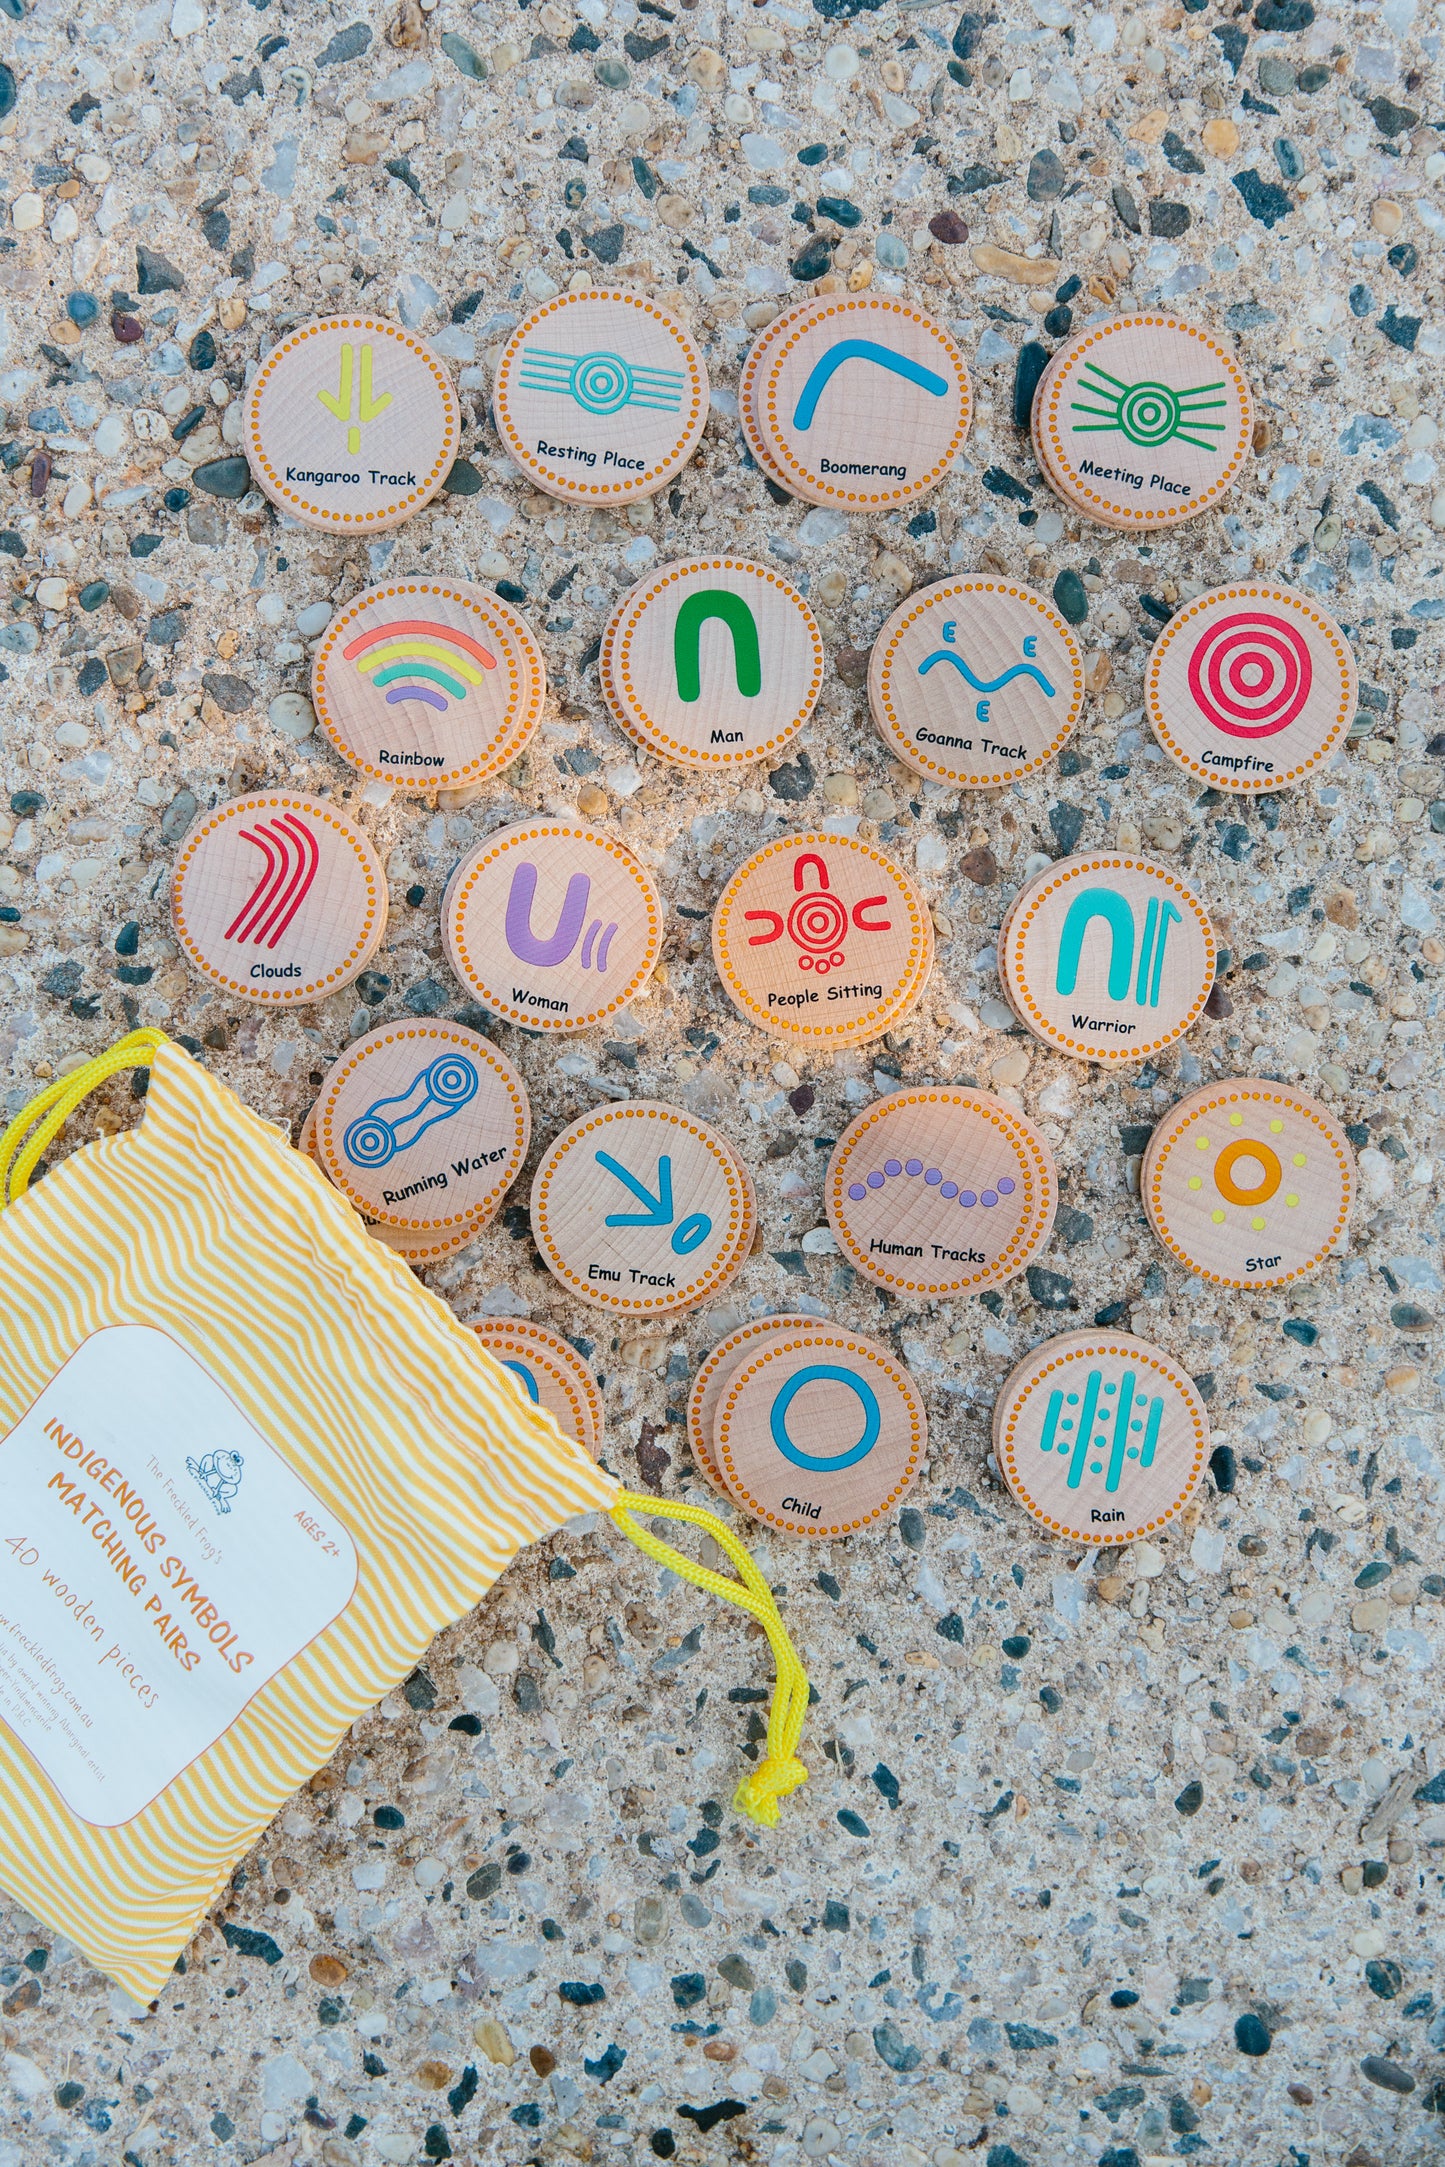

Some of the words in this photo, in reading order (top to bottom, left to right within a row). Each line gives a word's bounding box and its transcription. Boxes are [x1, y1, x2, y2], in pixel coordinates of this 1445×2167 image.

[537, 440, 597, 467] Resting
[603, 451, 645, 471] Place
[286, 466, 360, 487] Kangaroo
[368, 470, 416, 486] Track
[820, 458, 907, 481] Boomerang
[1079, 459, 1144, 489] Meeting
[1149, 474, 1192, 496] Place
[710, 729, 744, 744] Man
[915, 727, 973, 751] Goanna
[980, 738, 1028, 760] Track
[379, 749, 445, 767] Rainbow
[1201, 750, 1274, 773] Campfire
[249, 962, 302, 979] Clouds
[512, 987, 569, 1013] Woman
[768, 988, 820, 1009] People
[827, 984, 883, 1001] Sitting
[1071, 1014, 1136, 1035] Warrior
[382, 1172, 448, 1205] Running
[451, 1147, 507, 1177] Water
[869, 1238, 923, 1258] Human
[930, 1244, 986, 1264] Tracks
[1245, 1255, 1282, 1272] Star
[587, 1263, 622, 1281] Emu
[628, 1268, 676, 1288] Track
[146, 1454, 163, 1480] The
[162, 1478, 199, 1530] Freckled
[195, 1526, 223, 1565] Frog's
[781, 1497, 822, 1519] Child
[1090, 1508, 1126, 1523] Rain
[43, 1417, 166, 1554] INDIGENOUS
[160, 1556, 254, 1673] SYMBOLS
[293, 1510, 326, 1542] AGES
[321, 1541, 340, 1557] 2+
[48, 1471, 147, 1596] MATCHING
[144, 1594, 201, 1671] PAIRS
[4, 1537, 39, 1566] 40
[41, 1568, 104, 1642] wooden
[98, 1643, 159, 1709] pieces
[17, 1667, 39, 1690] award
[37, 1690, 59, 1721] winning
[59, 1718, 90, 1760] Aboriginal
[87, 1757, 106, 1783] artist
